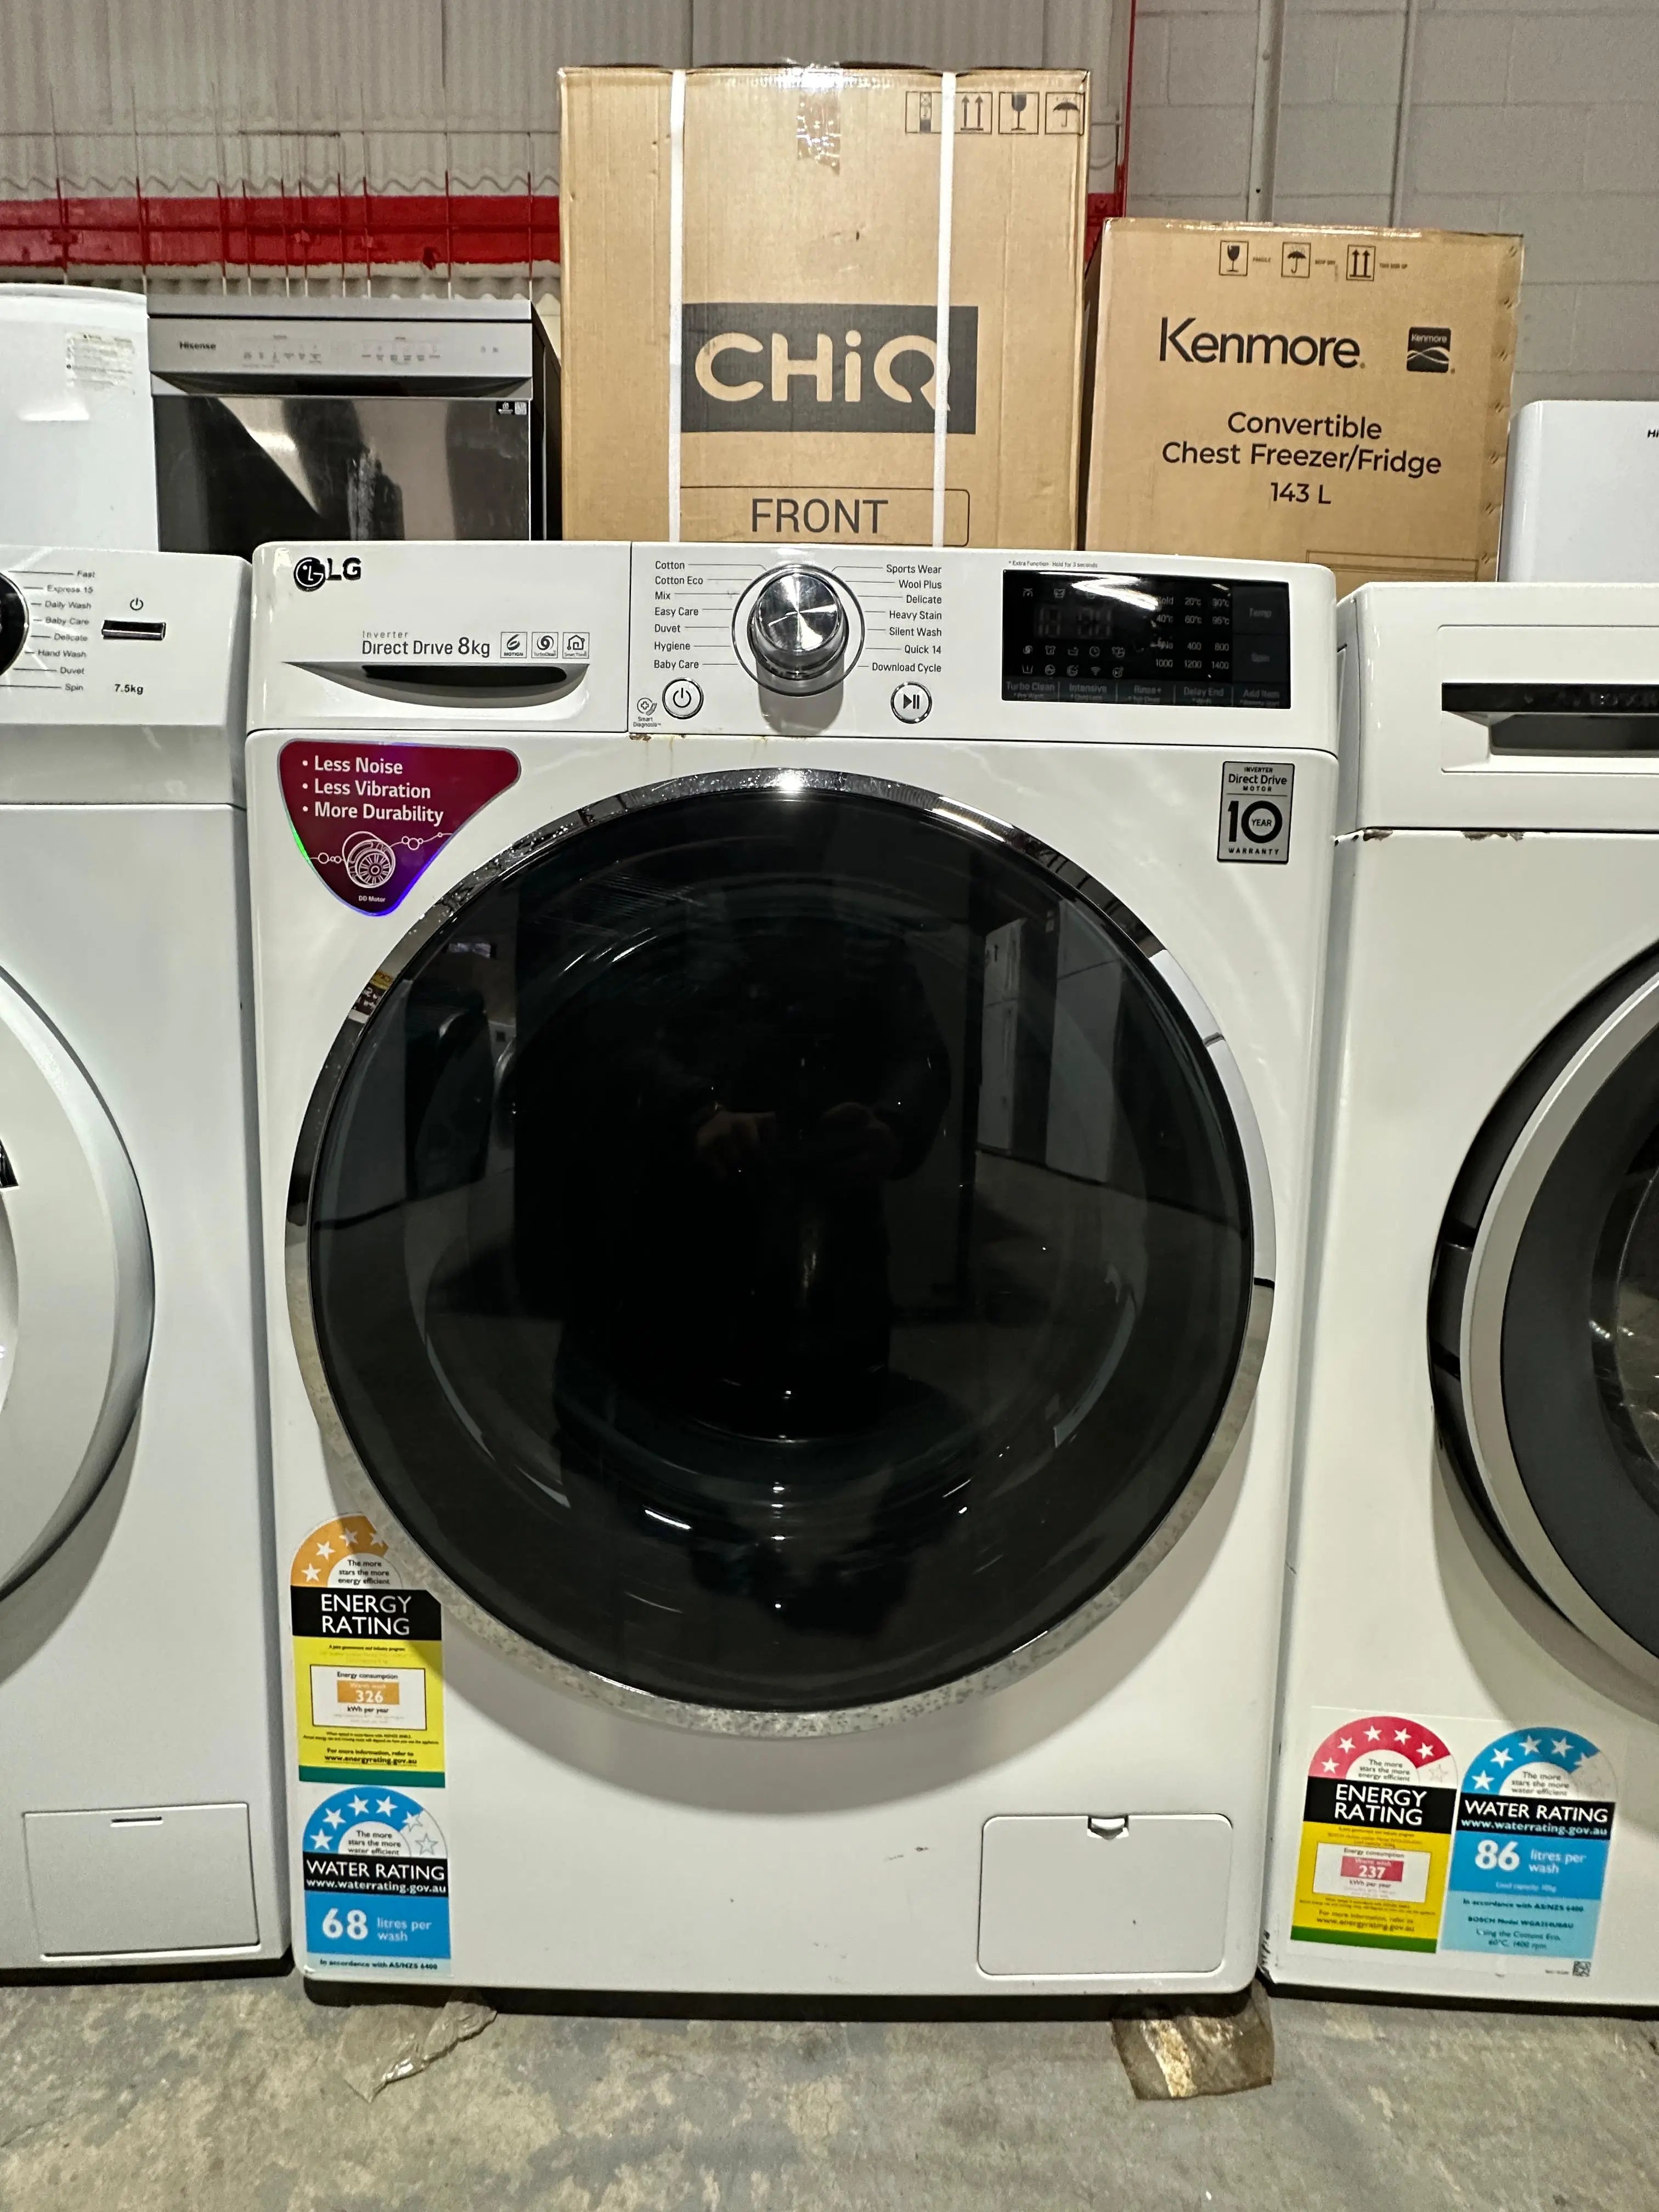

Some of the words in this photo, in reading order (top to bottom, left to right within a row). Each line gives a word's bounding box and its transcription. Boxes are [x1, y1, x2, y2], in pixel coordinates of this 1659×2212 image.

[1160, 317, 1360, 368] Kenmore
[1411, 334, 1447, 343] Kenmore
[180, 341, 216, 349] Hisense
[695, 330, 951, 411] CHiQ
[1228, 411, 1382, 439] Convertible
[1163, 441, 1240, 464] Chest
[1251, 443, 1442, 479] Freezer/Fridge
[1271, 482, 1310, 503] 143
[1319, 484, 1331, 504] L
[752, 499, 888, 534] FRONT
[326, 557, 362, 581] LG
[655, 561, 685, 569] Cotton
[887, 565, 916, 574] Sports
[918, 565, 942, 573] Wear
[655, 576, 684, 585] Cotton
[687, 576, 703, 585] Eco
[899, 580, 921, 589] Wool
[924, 580, 942, 589] Plus
[655, 591, 670, 600] Mix
[906, 595, 942, 603] Delicate
[45, 600, 65, 610] Daily
[655, 607, 676, 617] Easy
[679, 607, 698, 616] Care
[889, 611, 917, 621] Heavy
[919, 611, 942, 620] Stain
[46, 616, 66, 626] Baby
[654, 624, 680, 633] Duvet
[889, 627, 914, 636] Silent
[917, 627, 942, 636] Wash
[362, 630, 408, 639] Inverter
[362, 640, 408, 654] Direct
[413, 640, 453, 654] Drive
[458, 637, 490, 658] 8kg
[654, 641, 690, 652] Hygiene
[905, 645, 929, 654] Quick
[933, 646, 941, 654] 14
[654, 659, 676, 670] Baby
[679, 660, 699, 668] Care
[872, 663, 915, 672] Download
[918, 663, 941, 674] Cycle
[1184, 660, 1201, 668] 1200
[1212, 661, 1229, 669] 1400
[65, 684, 83, 692] Spin
[114, 684, 144, 695] 7.5kg
[1006, 681, 1030, 691] Turbo
[1184, 687, 1206, 696] Delay
[1209, 688, 1223, 696] End
[315, 755, 351, 772] Less
[356, 757, 403, 774] Noise
[1229, 774, 1258, 783] Direct
[1261, 775, 1287, 785] Drive
[315, 778, 351, 795] Less
[355, 781, 431, 799] Vibration
[315, 802, 358, 818] More
[363, 803, 444, 827] Durability
[1228, 800, 1283, 843] 10
[321, 1594, 411, 1613] ENERGY
[322, 1615, 410, 1635] RATING
[356, 1690, 383, 1703] 326
[1336, 1784, 1427, 1807] ENERGY
[1537, 1788, 1567, 1797] efficient
[1334, 1802, 1423, 1826] RATING
[1465, 1799, 1530, 1819] WATER
[1536, 1804, 1609, 1822] RATING
[1461, 1819, 1607, 1836] www.waterrating.gov.au
[357, 1830, 370, 1838] The
[1344, 1848, 1364, 1856] Energy
[1365, 1850, 1404, 1858] consumption
[1475, 1839, 1520, 1871] 86
[1531, 1849, 1561, 1861] litres
[1565, 1854, 1587, 1865] per
[306, 1860, 370, 1878] WATER
[376, 1864, 444, 1881] RATING
[1358, 1865, 1386, 1878] 237
[1529, 1863, 1559, 1874] wash
[306, 1878, 446, 1894] www.waterrating.gov.au
[322, 1908, 368, 1940] 68
[377, 1917, 407, 1928] litres
[411, 1921, 432, 1931] per
[377, 1931, 408, 1942] wash
